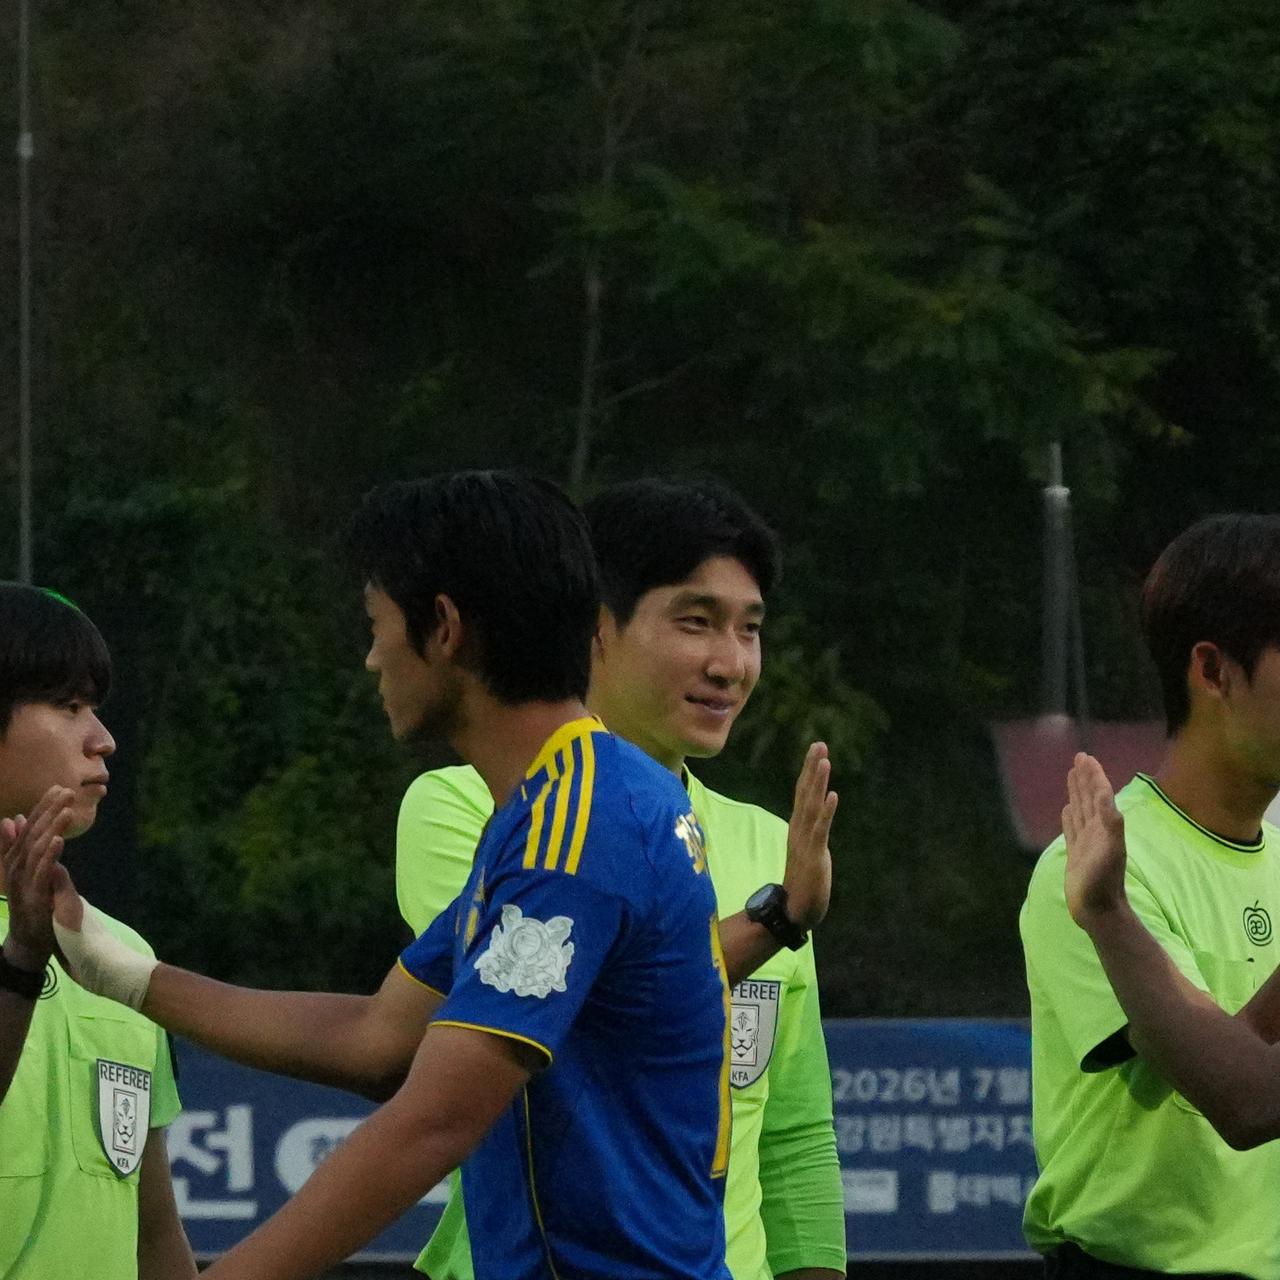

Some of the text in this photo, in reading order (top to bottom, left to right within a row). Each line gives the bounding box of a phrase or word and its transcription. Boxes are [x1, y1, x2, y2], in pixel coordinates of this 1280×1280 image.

[732, 983, 778, 1001] FEREE
[99, 1065, 151, 1092] REFEREE
[117, 1156, 131, 1170] KFA
